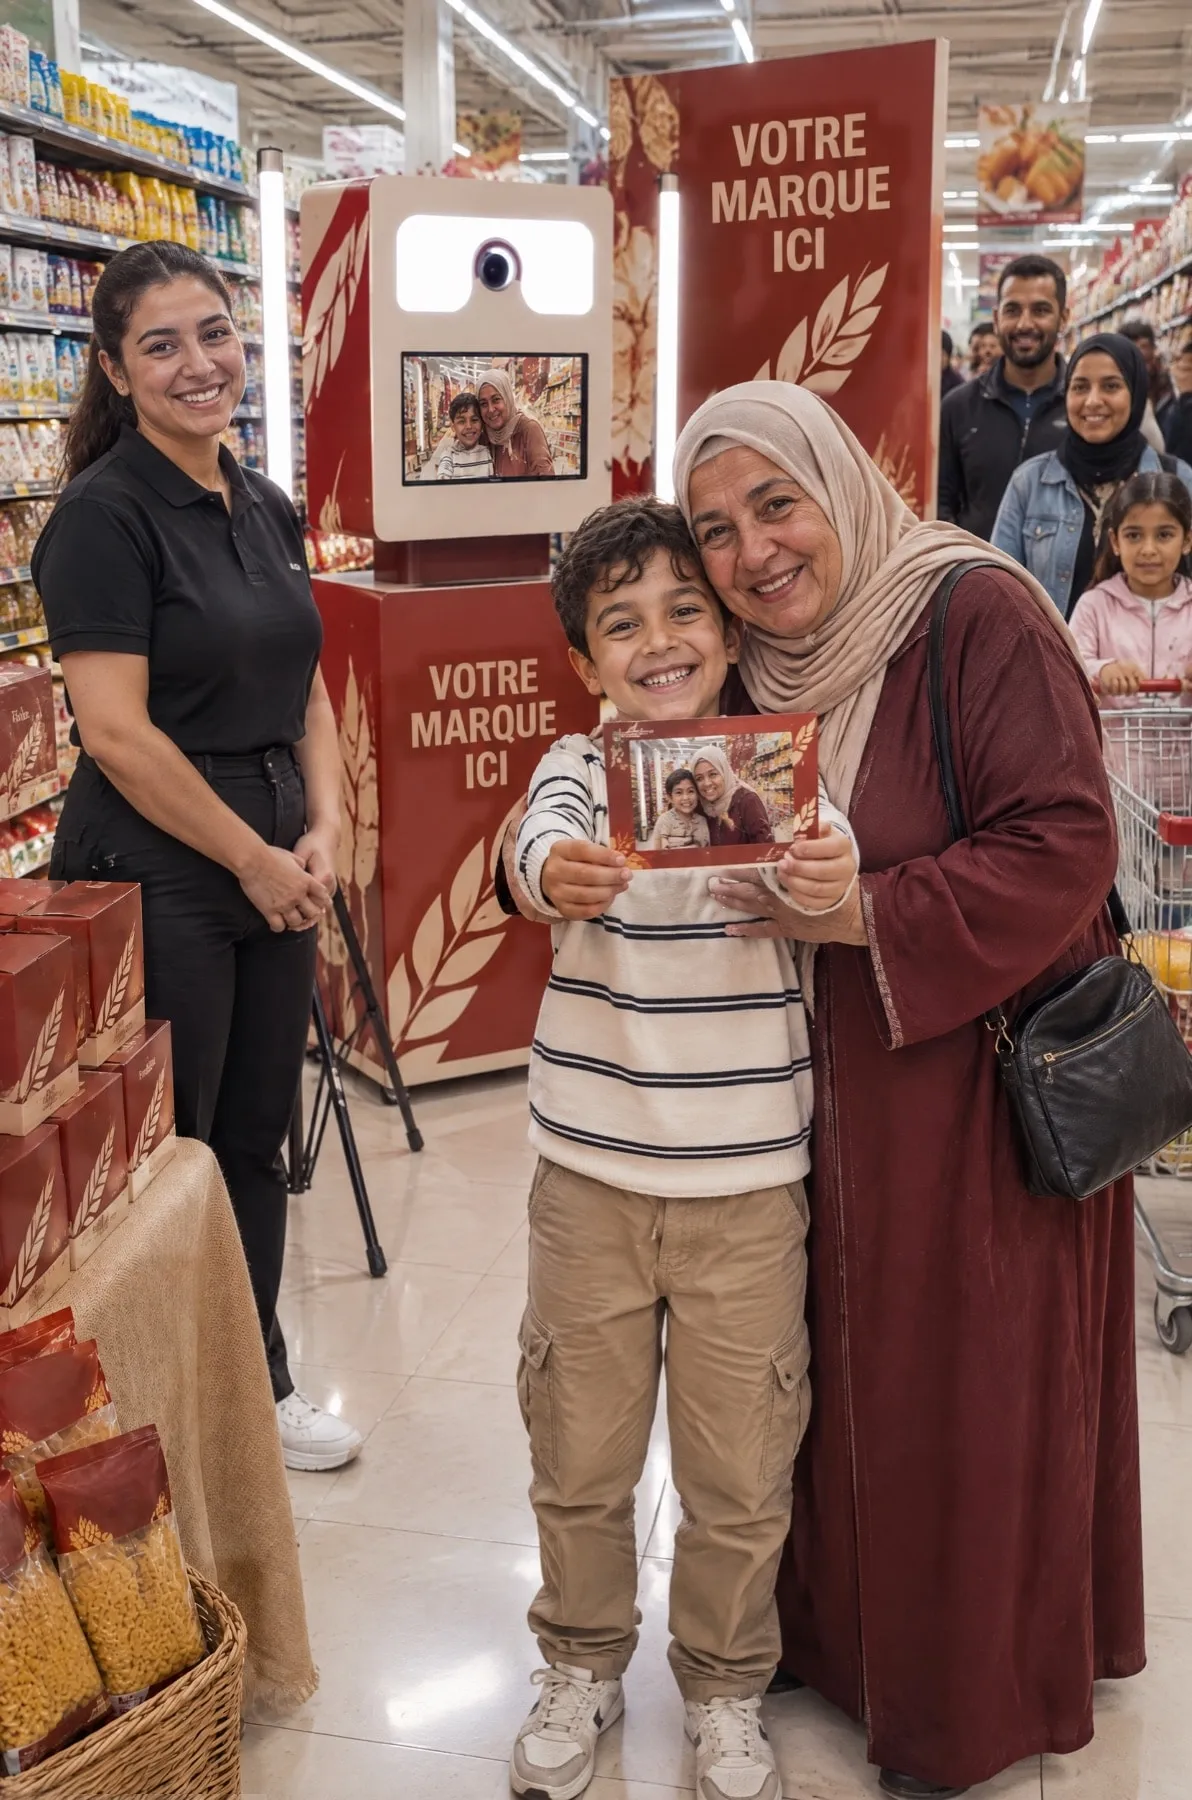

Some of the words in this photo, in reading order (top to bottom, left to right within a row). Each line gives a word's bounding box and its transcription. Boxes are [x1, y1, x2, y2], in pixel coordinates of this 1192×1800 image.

[731, 112, 867, 167] VOTRE
[711, 165, 891, 224] MARQUE
[773, 226, 825, 273] ICI
[428, 658, 539, 701] VOTRE
[411, 700, 557, 749] MARQUE
[465, 750, 508, 790] ICI
